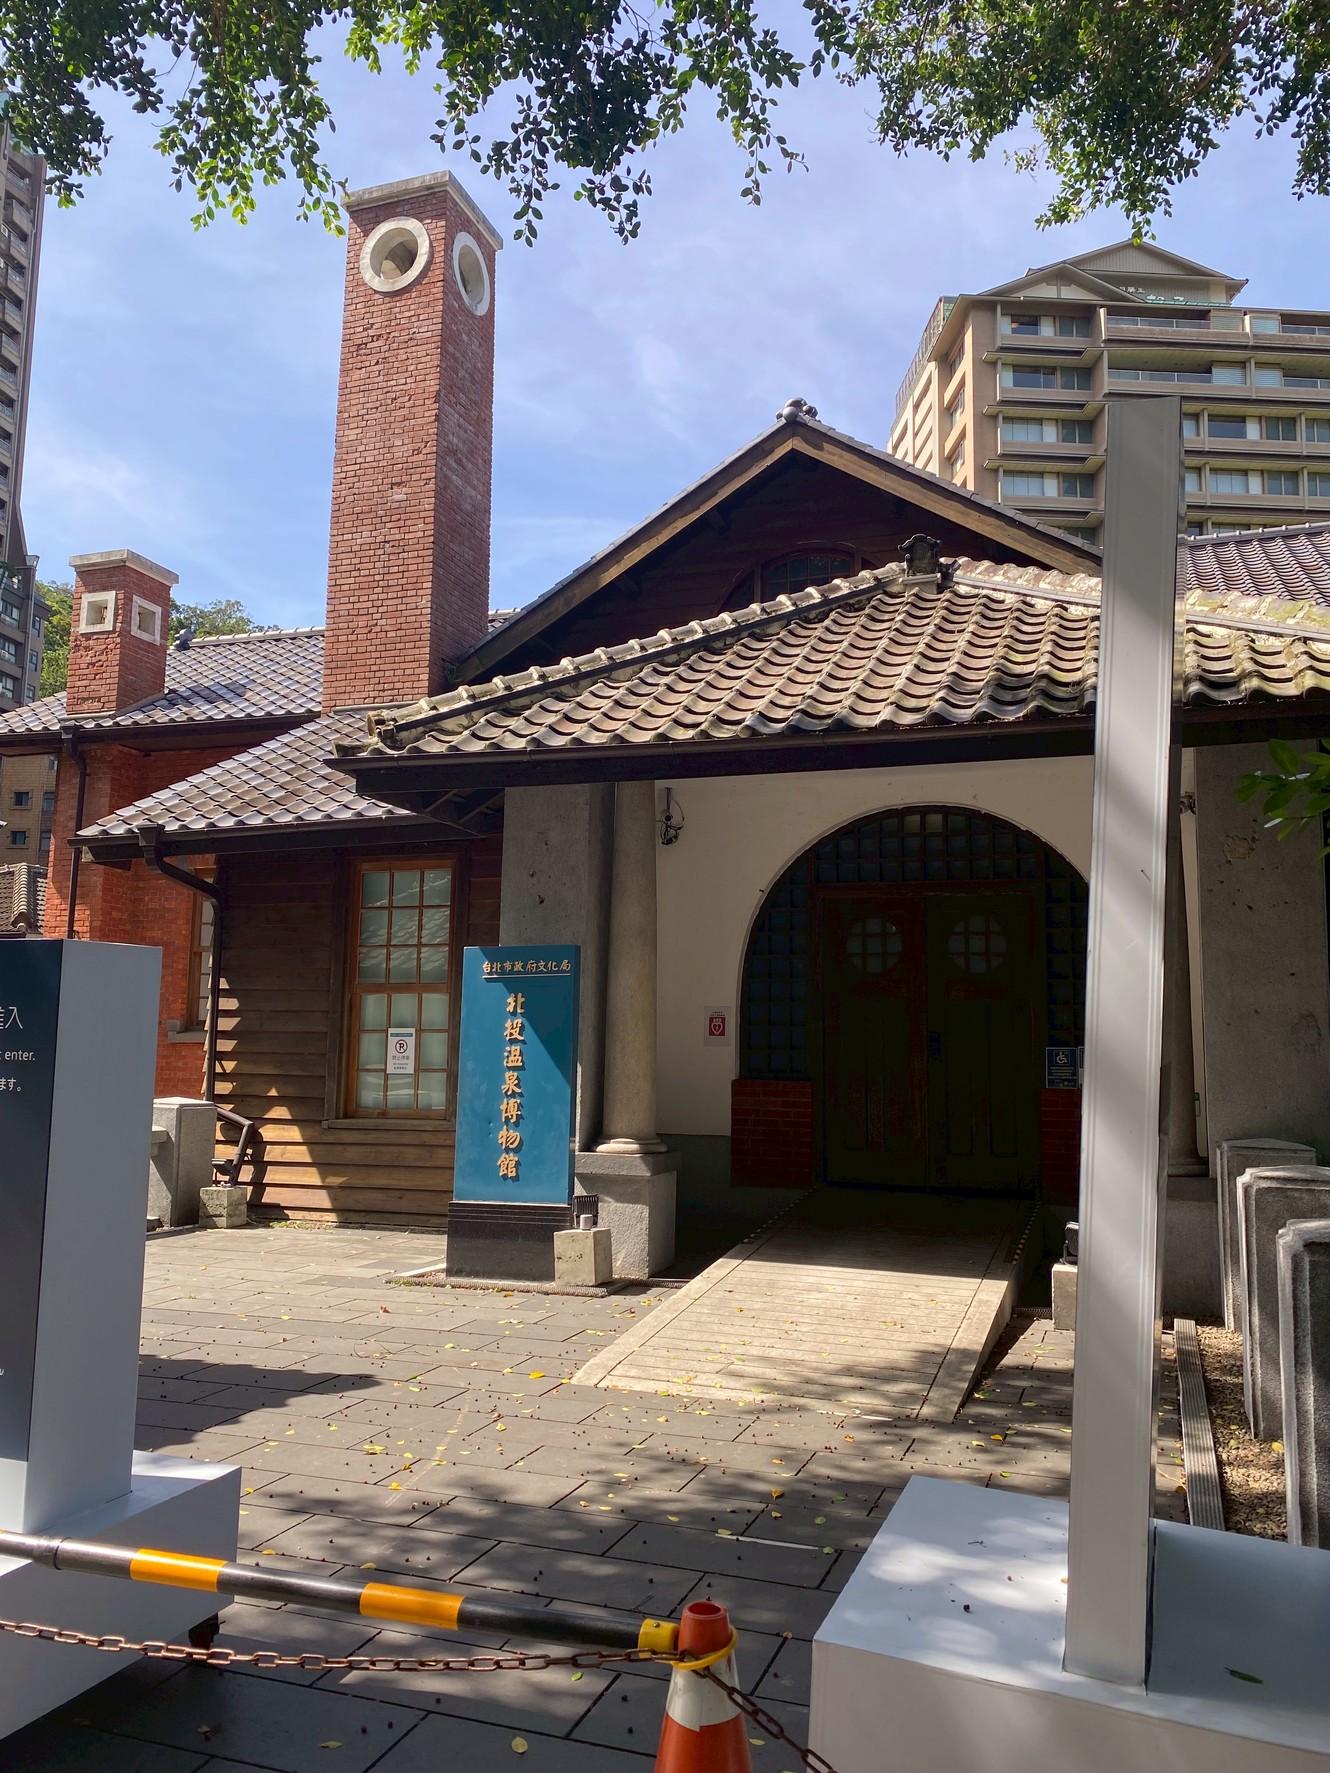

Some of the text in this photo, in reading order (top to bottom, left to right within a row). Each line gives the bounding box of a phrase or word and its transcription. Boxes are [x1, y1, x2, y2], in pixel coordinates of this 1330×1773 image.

[482, 960, 571, 973] 台北市政府文化局
[0, 1006, 23, 1029] 入
[4, 1050, 36, 1061] enter.
